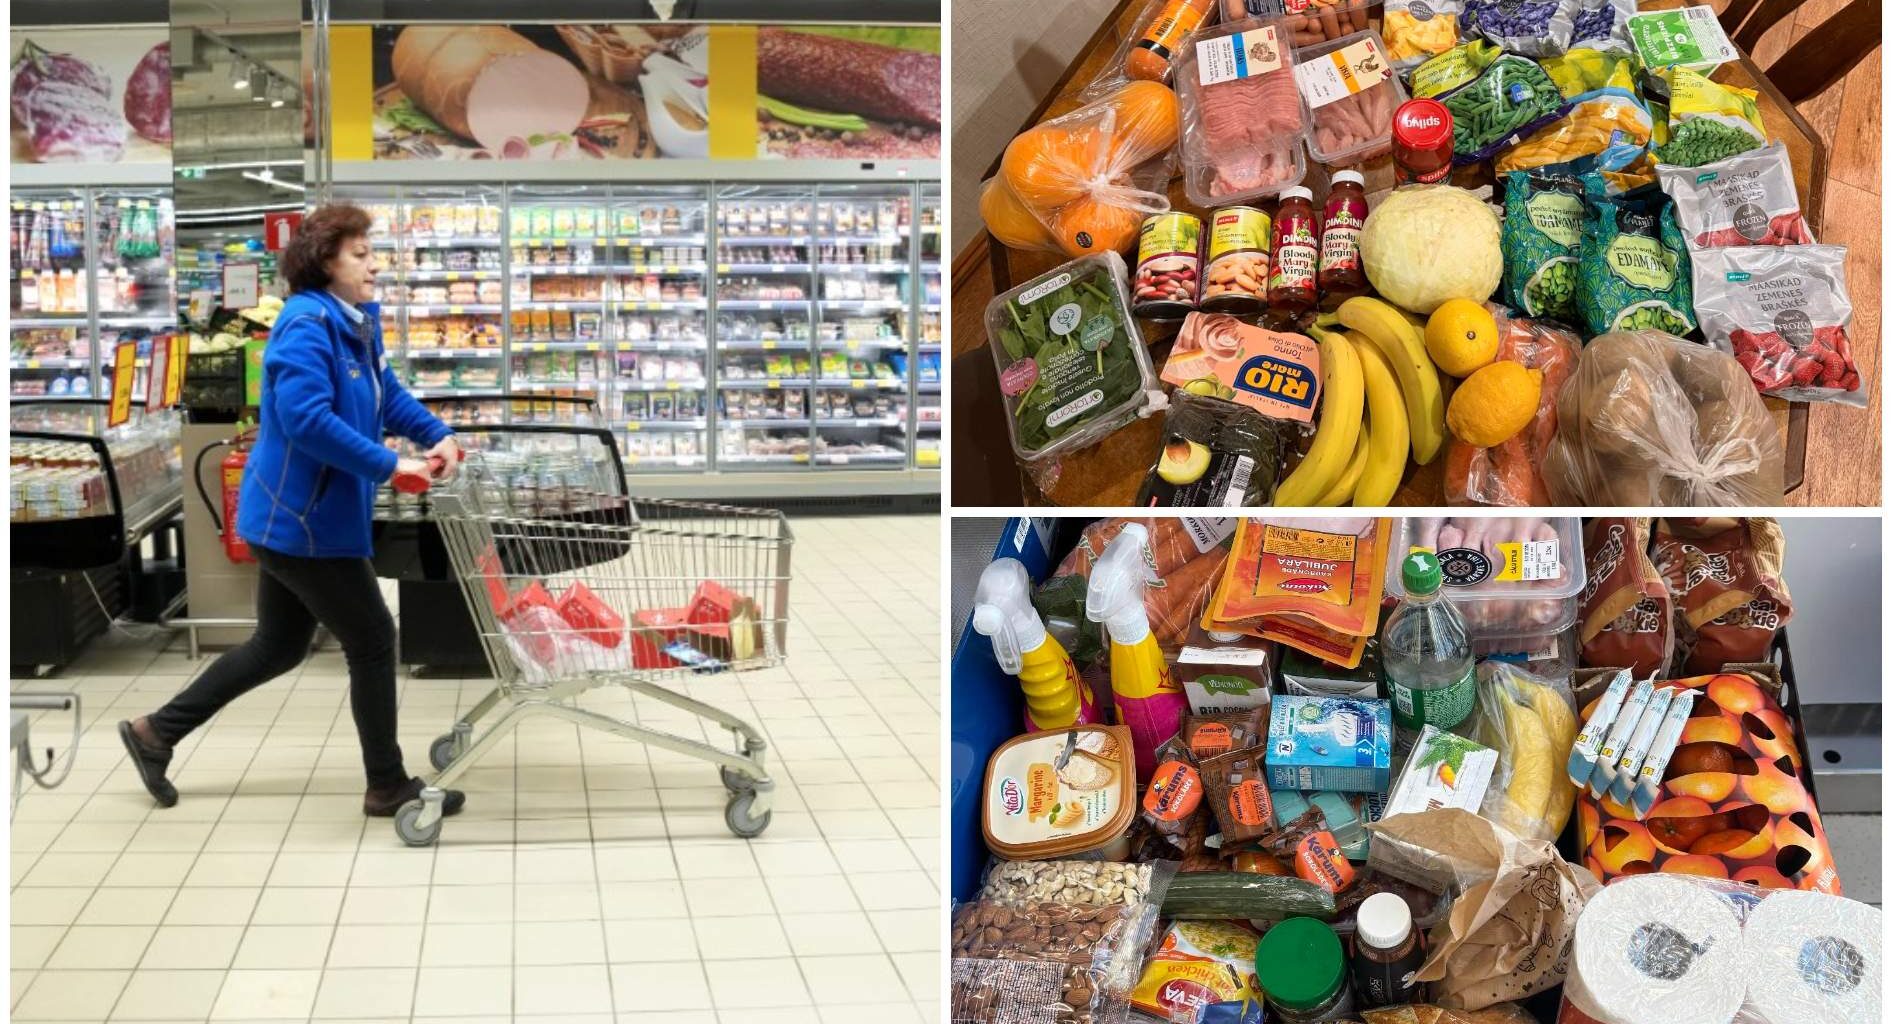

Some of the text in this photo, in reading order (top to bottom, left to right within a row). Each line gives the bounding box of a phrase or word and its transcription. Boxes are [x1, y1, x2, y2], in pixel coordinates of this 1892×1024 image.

[1736, 216, 1765, 225] FROZEN
[1325, 233, 1356, 242] Bloody
[1283, 250, 1314, 261] Bloody
[1284, 259, 1309, 269] Mary
[1284, 267, 1312, 276] Virgin
[1750, 278, 1800, 291] MAASIKAD
[1756, 289, 1803, 301] ZEMENES
[1274, 345, 1302, 360] Tonno
[1048, 364, 1081, 382] vengono
[1067, 365, 1093, 381] Queste
[1261, 362, 1301, 377] mare
[1245, 368, 1309, 399] RIO
[1037, 374, 1104, 411] Prodotto non lavato
[1278, 559, 1337, 570] JUBILĀRA
[1031, 769, 1046, 813] Margarine
[1153, 765, 1187, 815] Karums
[1307, 836, 1344, 887] Karums
[1168, 966, 1214, 981] chicken
